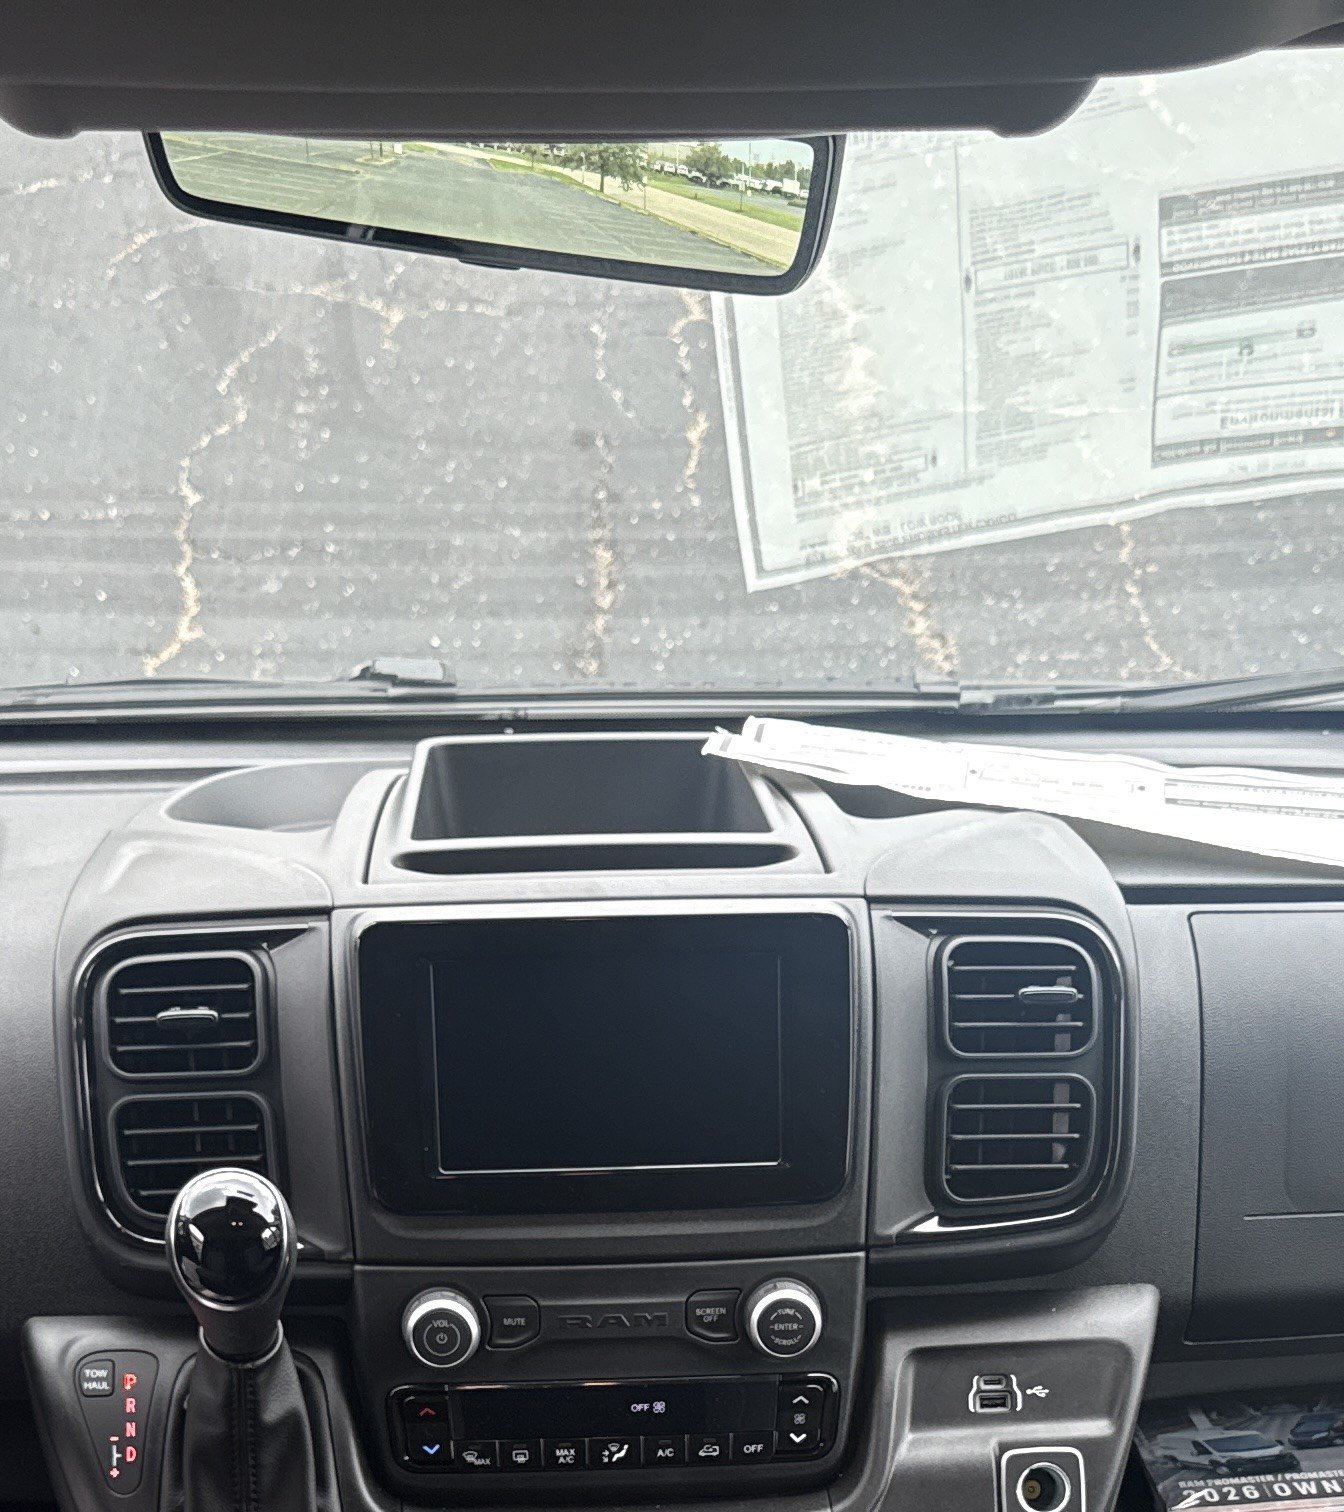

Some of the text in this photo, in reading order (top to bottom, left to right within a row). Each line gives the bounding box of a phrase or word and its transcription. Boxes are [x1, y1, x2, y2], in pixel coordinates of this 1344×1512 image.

[695, 1307, 726, 1315] SCREEN
[778, 1308, 796, 1316] TUNE
[431, 1319, 450, 1328] VOL
[503, 1317, 526, 1326] MUTE
[703, 1315, 718, 1323] OFF
[84, 1369, 109, 1378] TOW
[83, 1381, 110, 1390] HAUL
[123, 1373, 137, 1390] P
[125, 1397, 136, 1413] R
[630, 1402, 650, 1413] OFF
[125, 1421, 136, 1437] N
[657, 1447, 674, 1458] A/C
[743, 1444, 764, 1454] OFF
[125, 1446, 137, 1462] D
[558, 1456, 575, 1464] A/C
